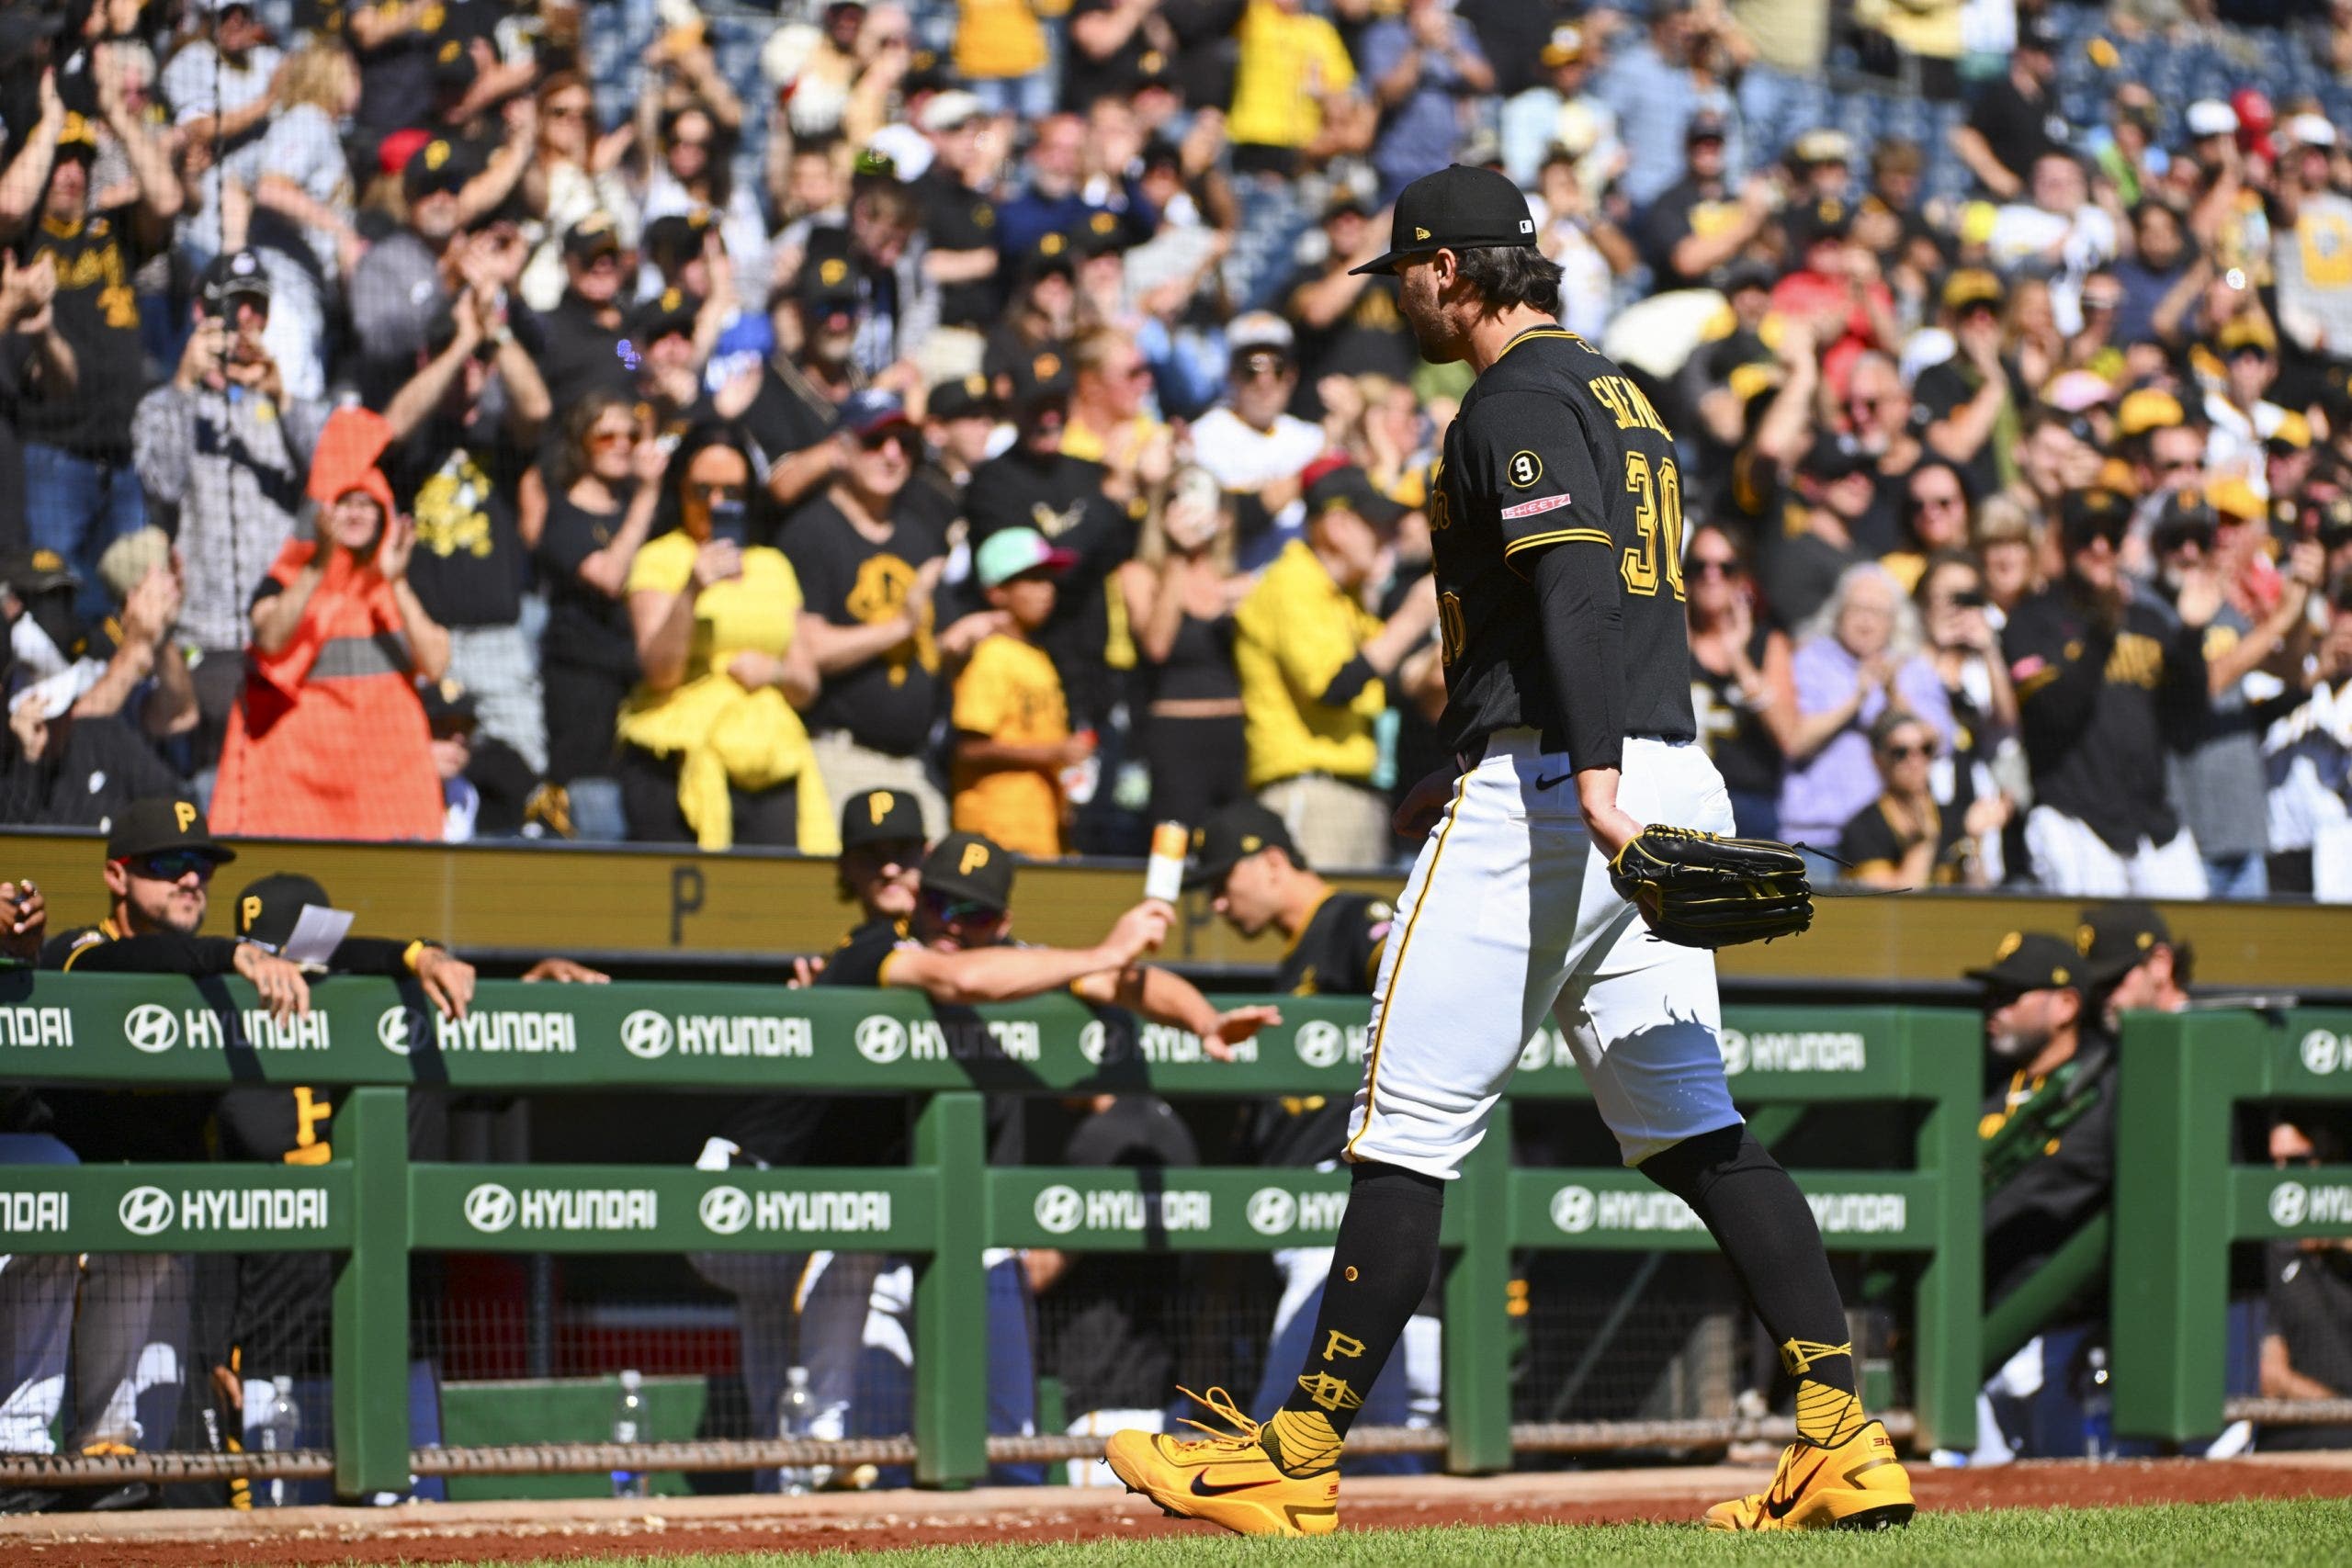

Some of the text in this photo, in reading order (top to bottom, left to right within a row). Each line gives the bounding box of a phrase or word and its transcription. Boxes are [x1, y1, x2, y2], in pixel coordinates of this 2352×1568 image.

[1516, 456, 1534, 482] 9
[1504, 497, 1569, 518] SHEETZ
[1621, 450, 1686, 603] 30
[175, 801, 197, 833] P
[868, 791, 895, 826] P
[958, 842, 989, 875] P
[243, 896, 263, 932] P
[185, 1008, 330, 1050] HYUNDAI
[436, 1010, 577, 1053] HYUNDAI
[677, 1015, 814, 1058] HYUNDAI
[910, 1020, 1041, 1062] HYUNDAI
[1751, 1032, 1867, 1073] HYUNDAI
[182, 1189, 328, 1230] HYUNDAI
[521, 1190, 658, 1231] HYUNDAI
[756, 1191, 892, 1232] HYUNDAI
[1086, 1190, 1212, 1232] HYUNDAI
[1322, 1329, 1367, 1362] P
